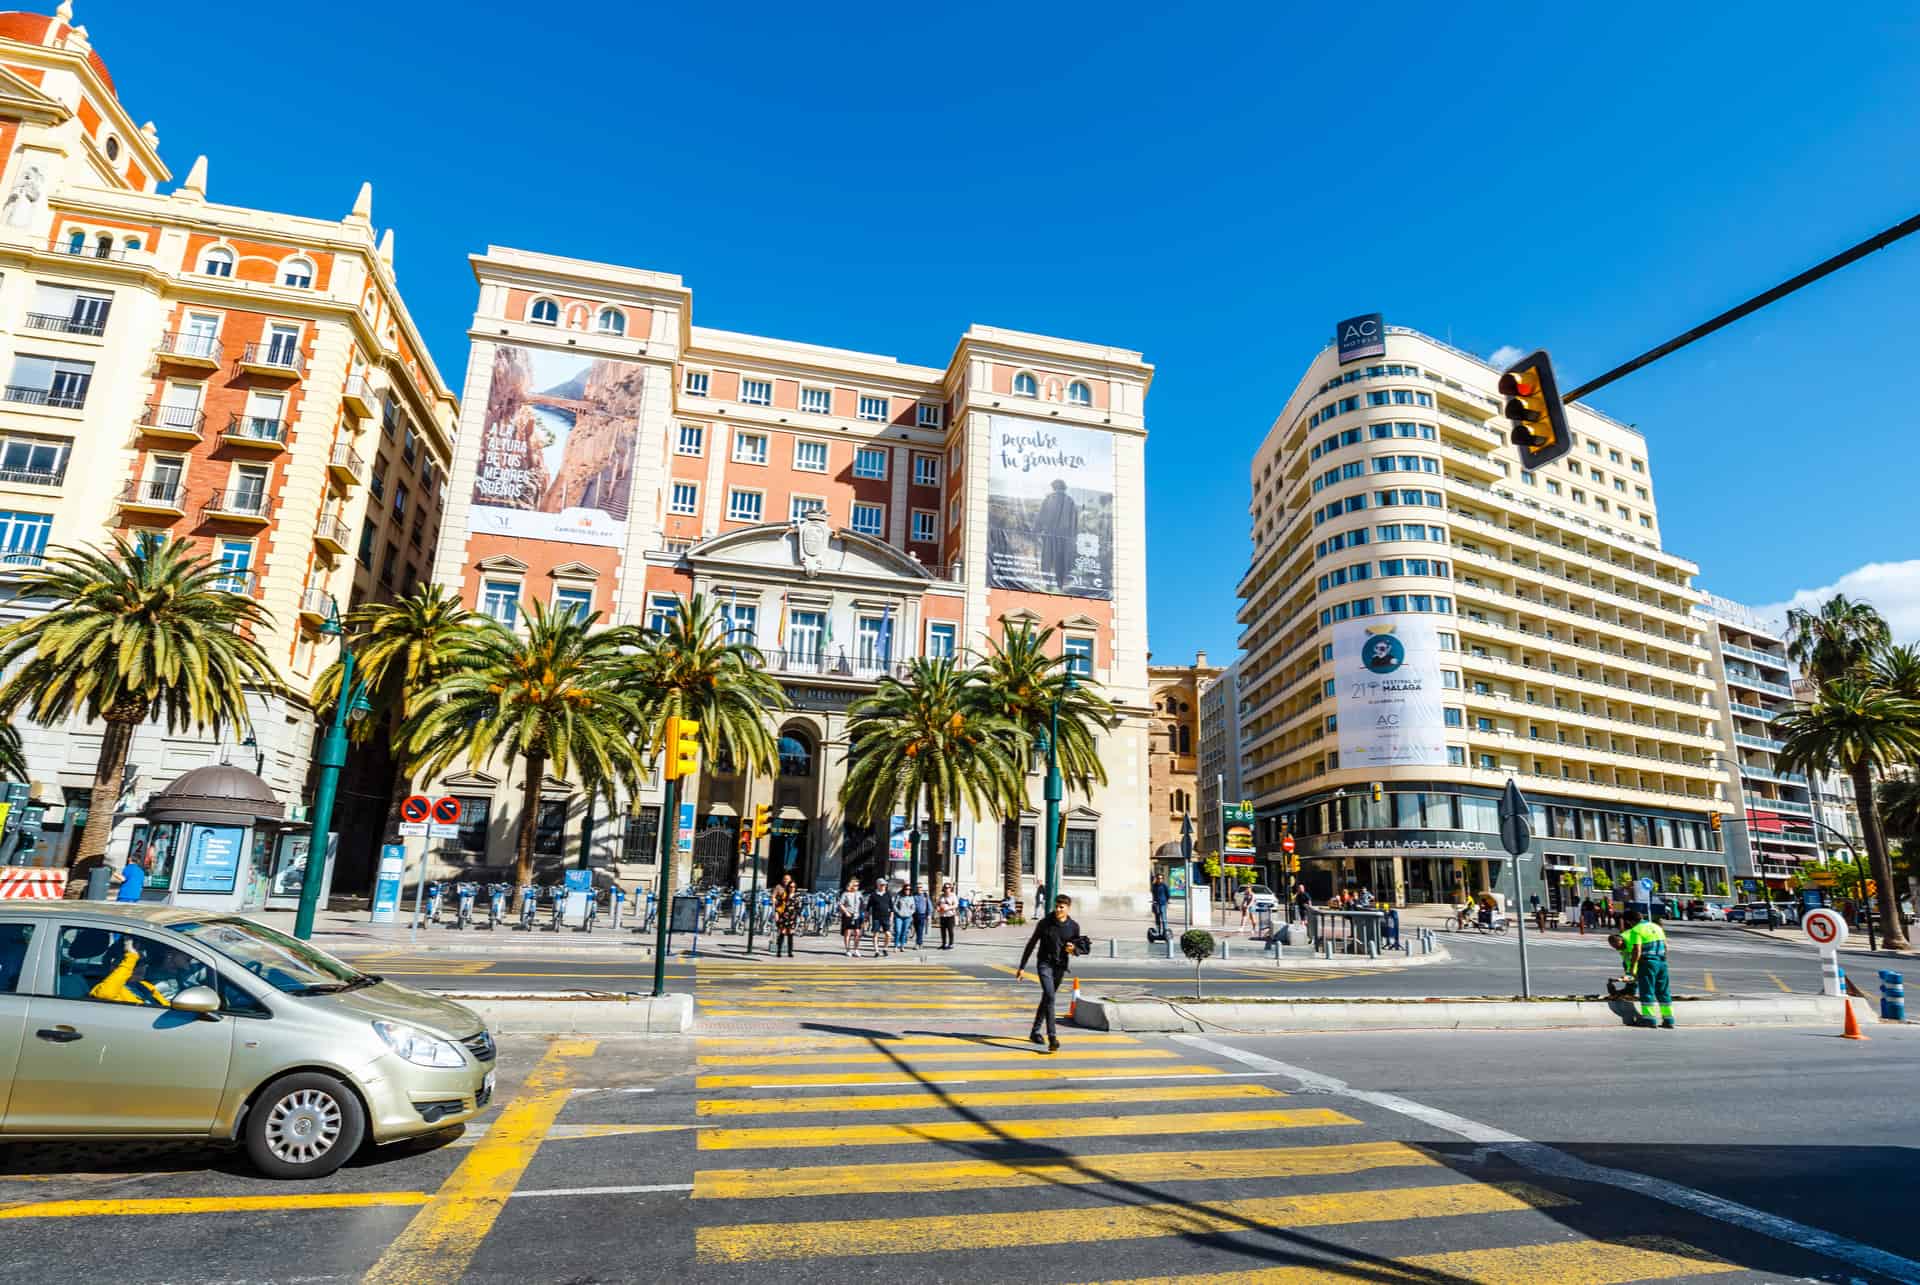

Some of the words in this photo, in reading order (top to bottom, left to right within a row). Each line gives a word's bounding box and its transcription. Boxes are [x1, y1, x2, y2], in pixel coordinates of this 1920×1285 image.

[1344, 320, 1376, 342] AC
[488, 437, 528, 453] ALTURA
[1002, 430, 1057, 453] Descubre
[485, 450, 499, 466] DE
[500, 452, 522, 467] TUS
[1000, 449, 1018, 469] tu
[1022, 449, 1087, 472] grandeza
[1376, 713, 1400, 726] AC
[956, 839, 965, 854] P
[1436, 840, 1488, 852] PALACIO
